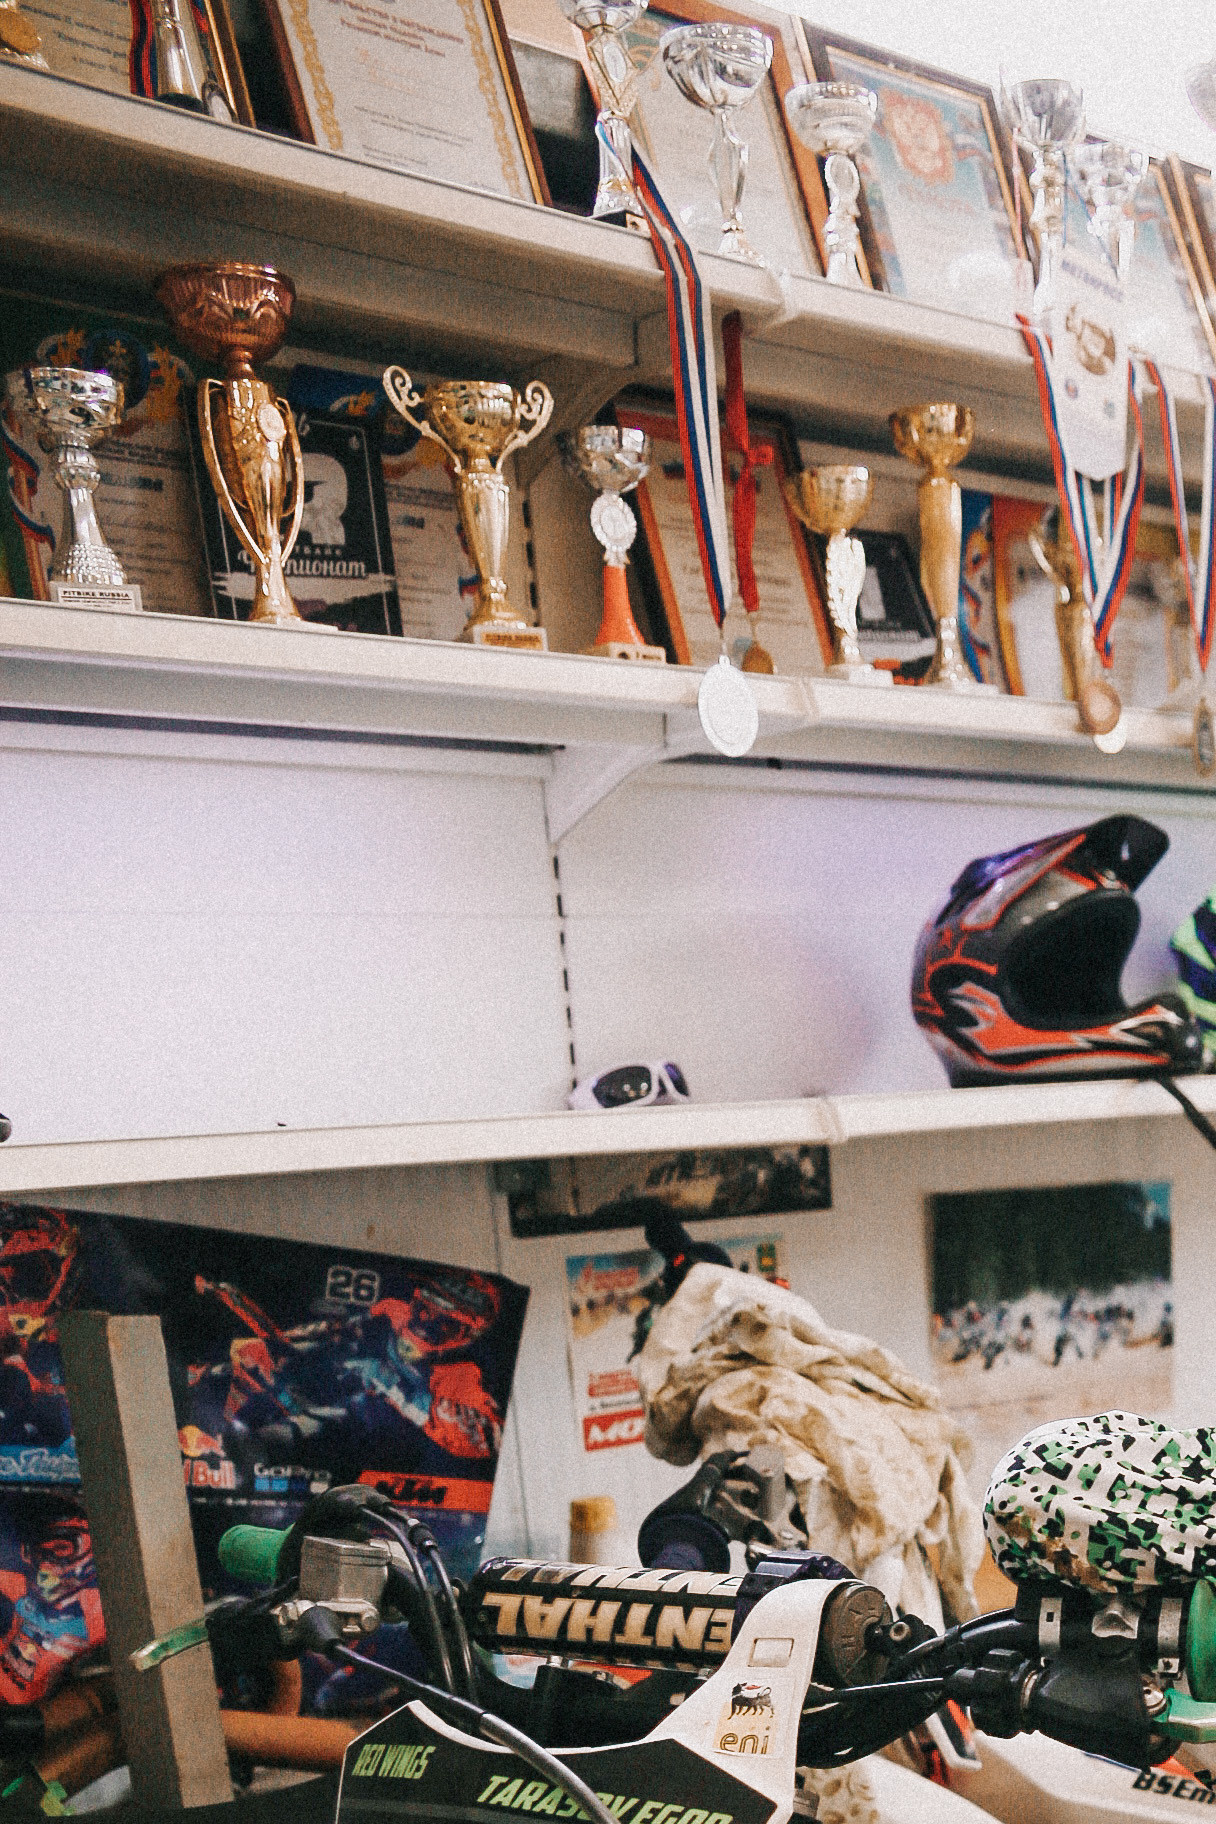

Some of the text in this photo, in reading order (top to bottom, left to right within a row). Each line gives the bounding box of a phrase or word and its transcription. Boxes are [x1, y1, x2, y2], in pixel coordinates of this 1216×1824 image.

[325, 1266, 380, 1304] 26
[192, 1460, 236, 1489] Bull
[482, 1592, 736, 1654] ENTHAL
[720, 1725, 771, 1754] eni
[351, 1744, 436, 1779] RED WINGS
